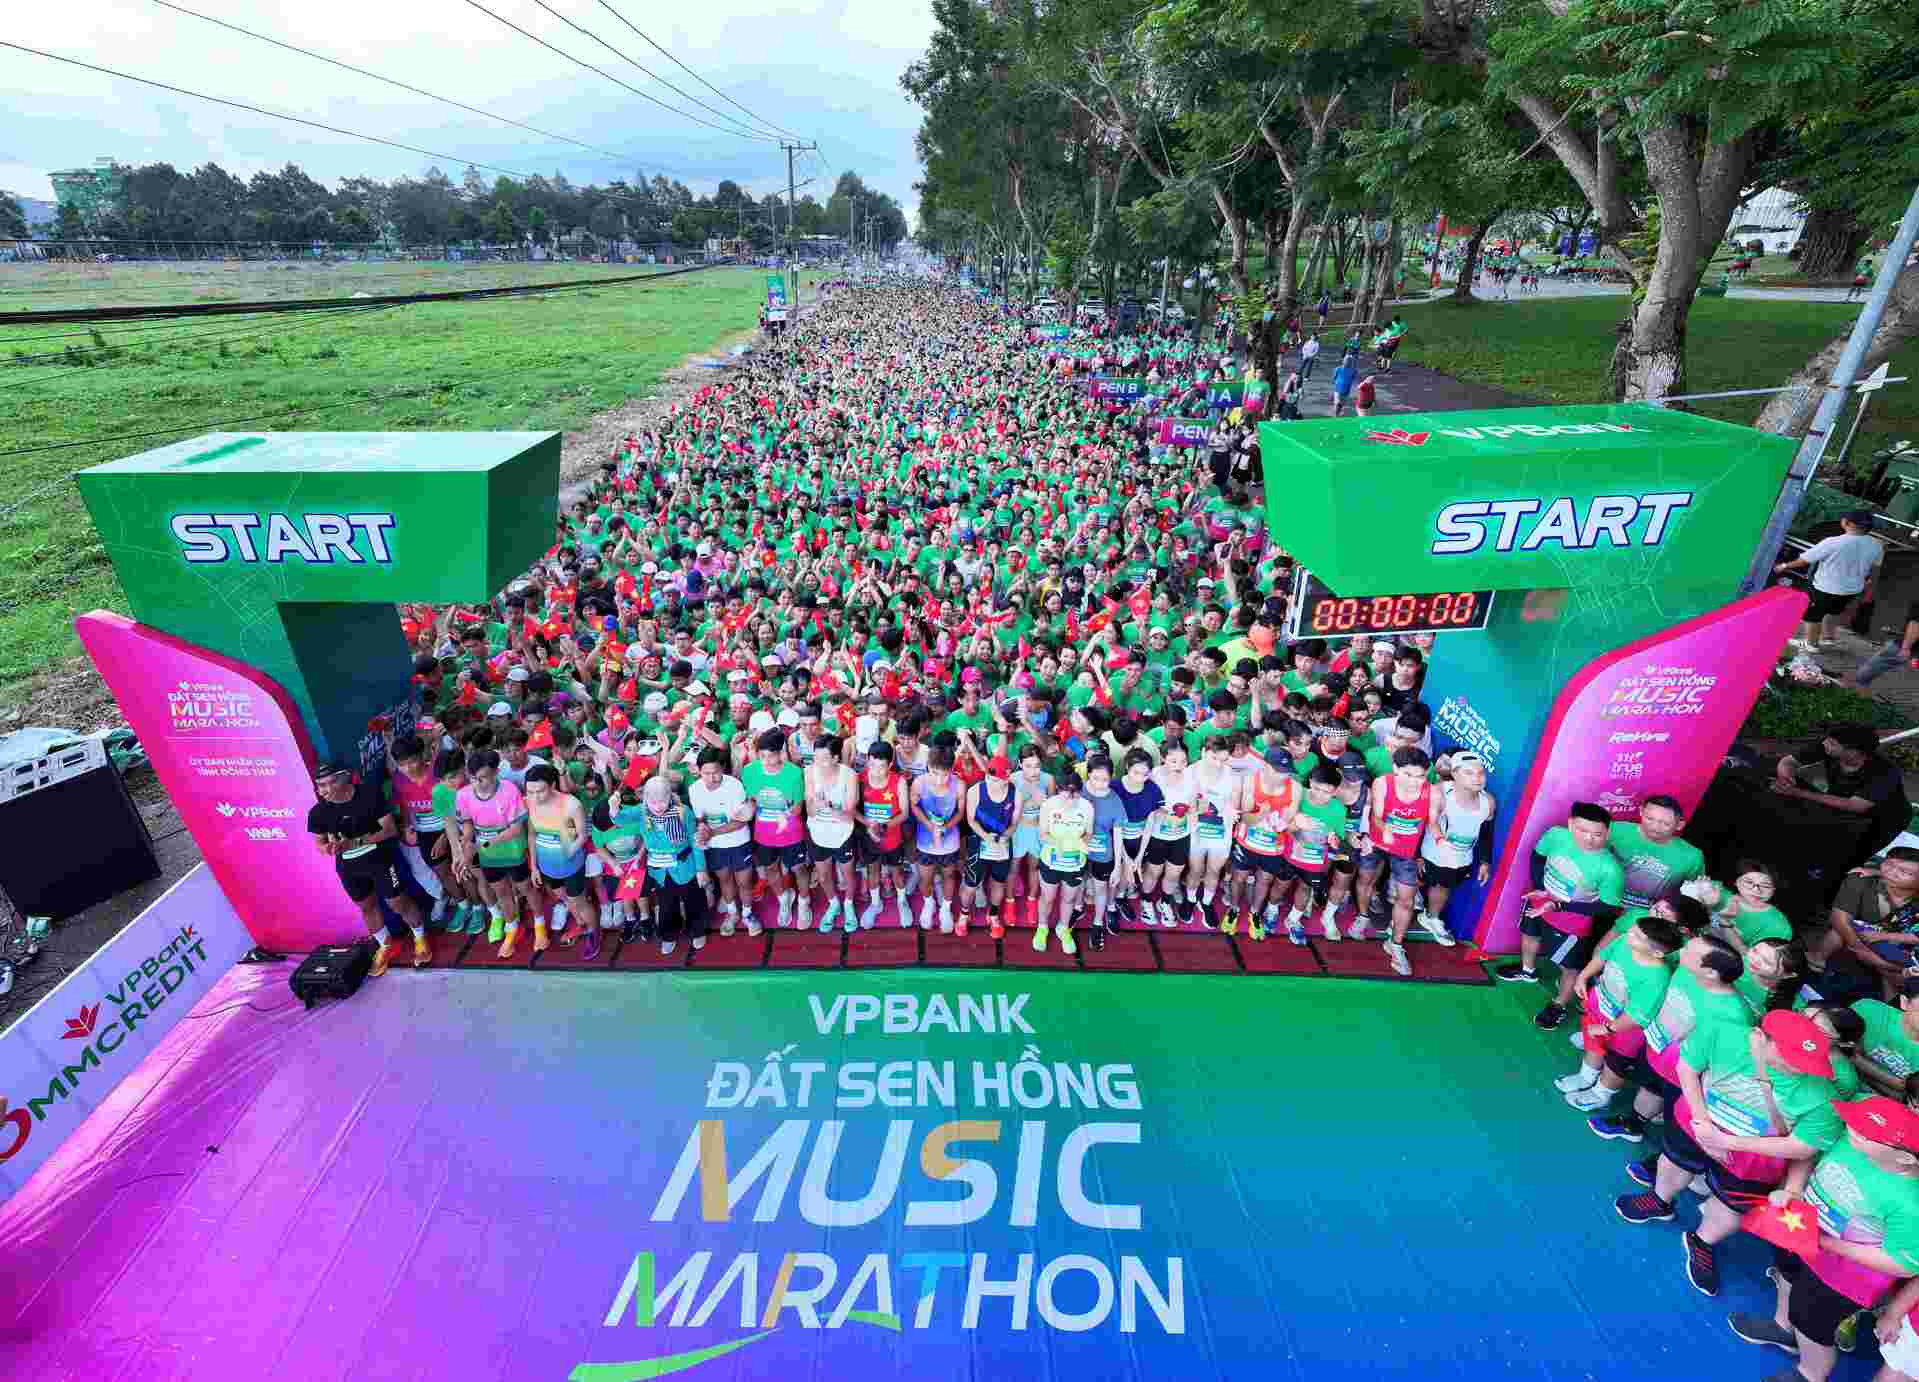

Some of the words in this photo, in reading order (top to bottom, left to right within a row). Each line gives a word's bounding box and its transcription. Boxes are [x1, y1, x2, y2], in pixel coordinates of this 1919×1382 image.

[1099, 383, 1126, 394] PEN
[1128, 383, 1137, 393] B
[1219, 390, 1232, 402] A
[1172, 426, 1208, 440] PEN
[1437, 422, 1654, 440] VPBank
[169, 512, 396, 564] START
[1430, 491, 1695, 555] START
[1312, 592, 1475, 631] 00:00:00
[170, 702, 252, 717] MUSIC
[1610, 686, 1711, 703] MUSIC
[1437, 703, 1498, 765] MUSIC
[105, 924, 199, 1005] VPBank
[807, 992, 1036, 1035] VPBANK
[705, 1043, 827, 1109] ĐẤT
[836, 1060, 956, 1109] SEN
[972, 1043, 1144, 1110] HỒNG
[650, 1119, 1142, 1230] MUSIC
[603, 1250, 1186, 1335] MARATHON
